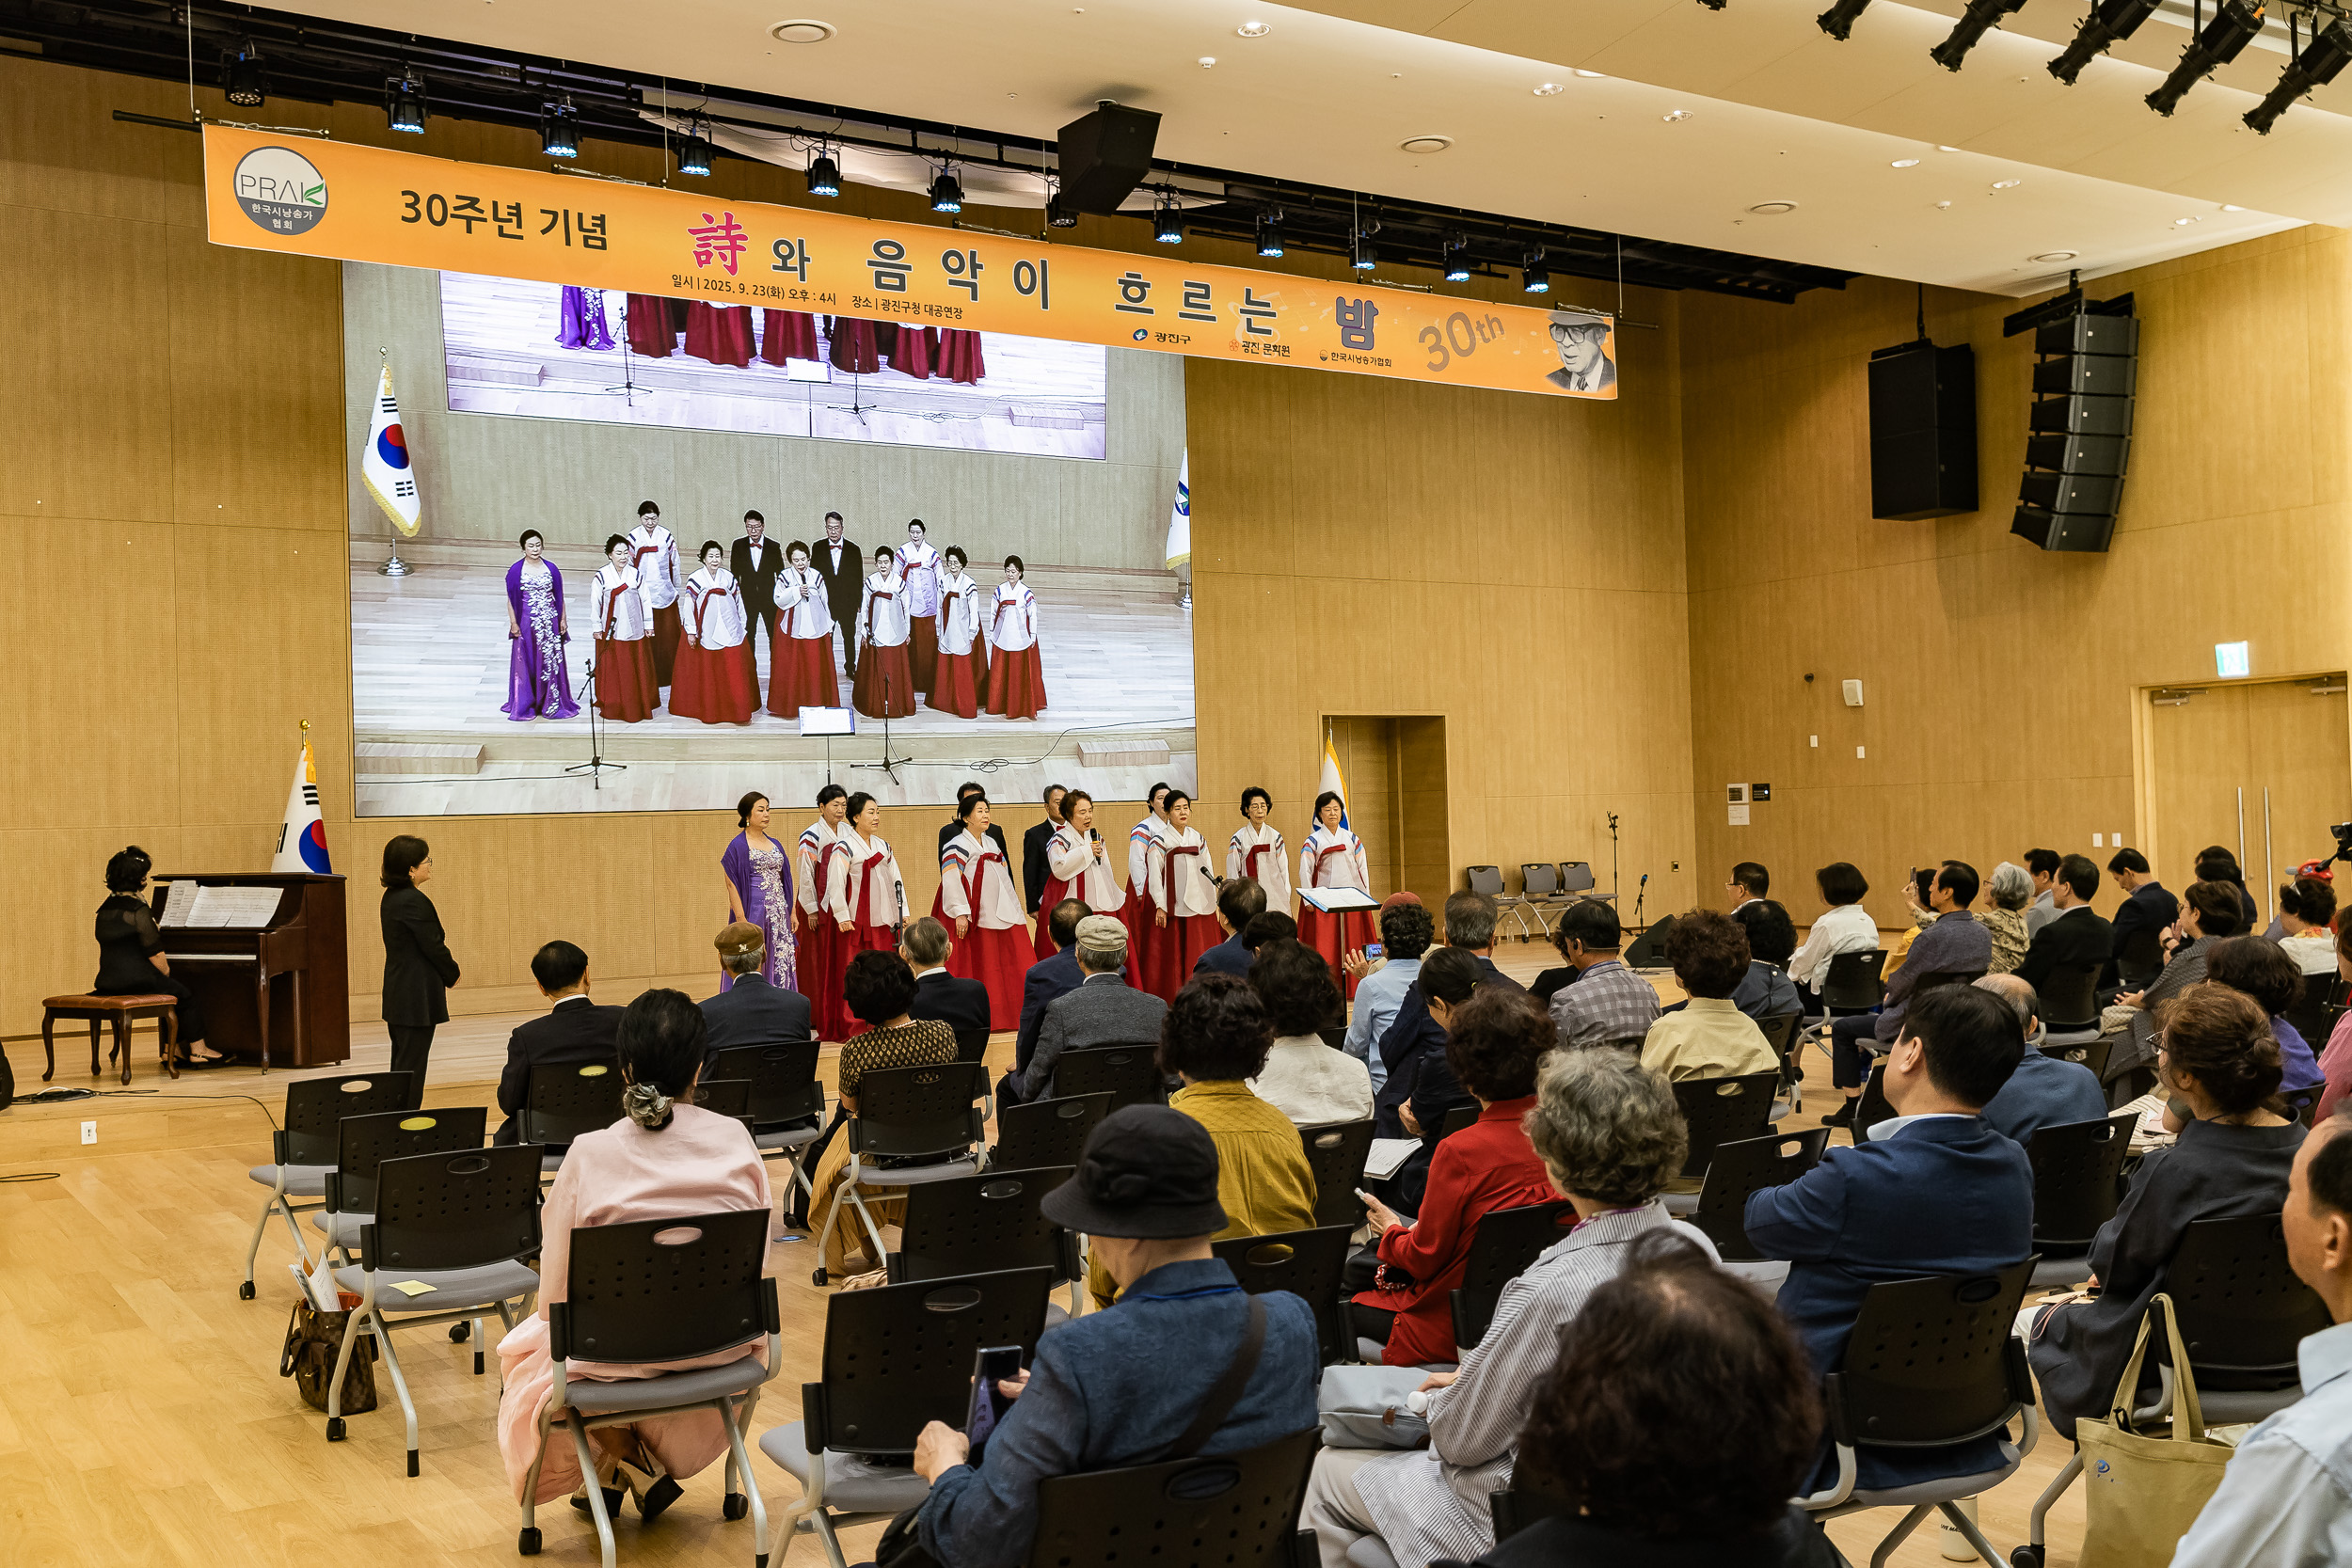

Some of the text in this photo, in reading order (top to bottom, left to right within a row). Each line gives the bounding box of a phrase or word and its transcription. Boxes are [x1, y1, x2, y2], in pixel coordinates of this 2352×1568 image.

[251, 202, 313, 221] 한국시낭송가
[400, 190, 609, 251] 30주년 기념
[272, 218, 293, 230] 협회
[672, 274, 693, 289] 일시
[752, 284, 785, 300] 23(화)
[787, 288, 810, 302] 오후
[819, 293, 836, 306] 4시
[851, 295, 873, 309] 장소
[881, 299, 920, 315] 광진구청
[924, 304, 963, 320] 대공연장
[1114, 271, 1278, 337] 흐르는
[1335, 295, 1379, 351] 밤
[1153, 331, 1192, 345] 광진구
[1241, 341, 1291, 357] 광진 문화원
[1418, 311, 1505, 372] 30th
[1330, 352, 1392, 368] 한국시낭송가협회
